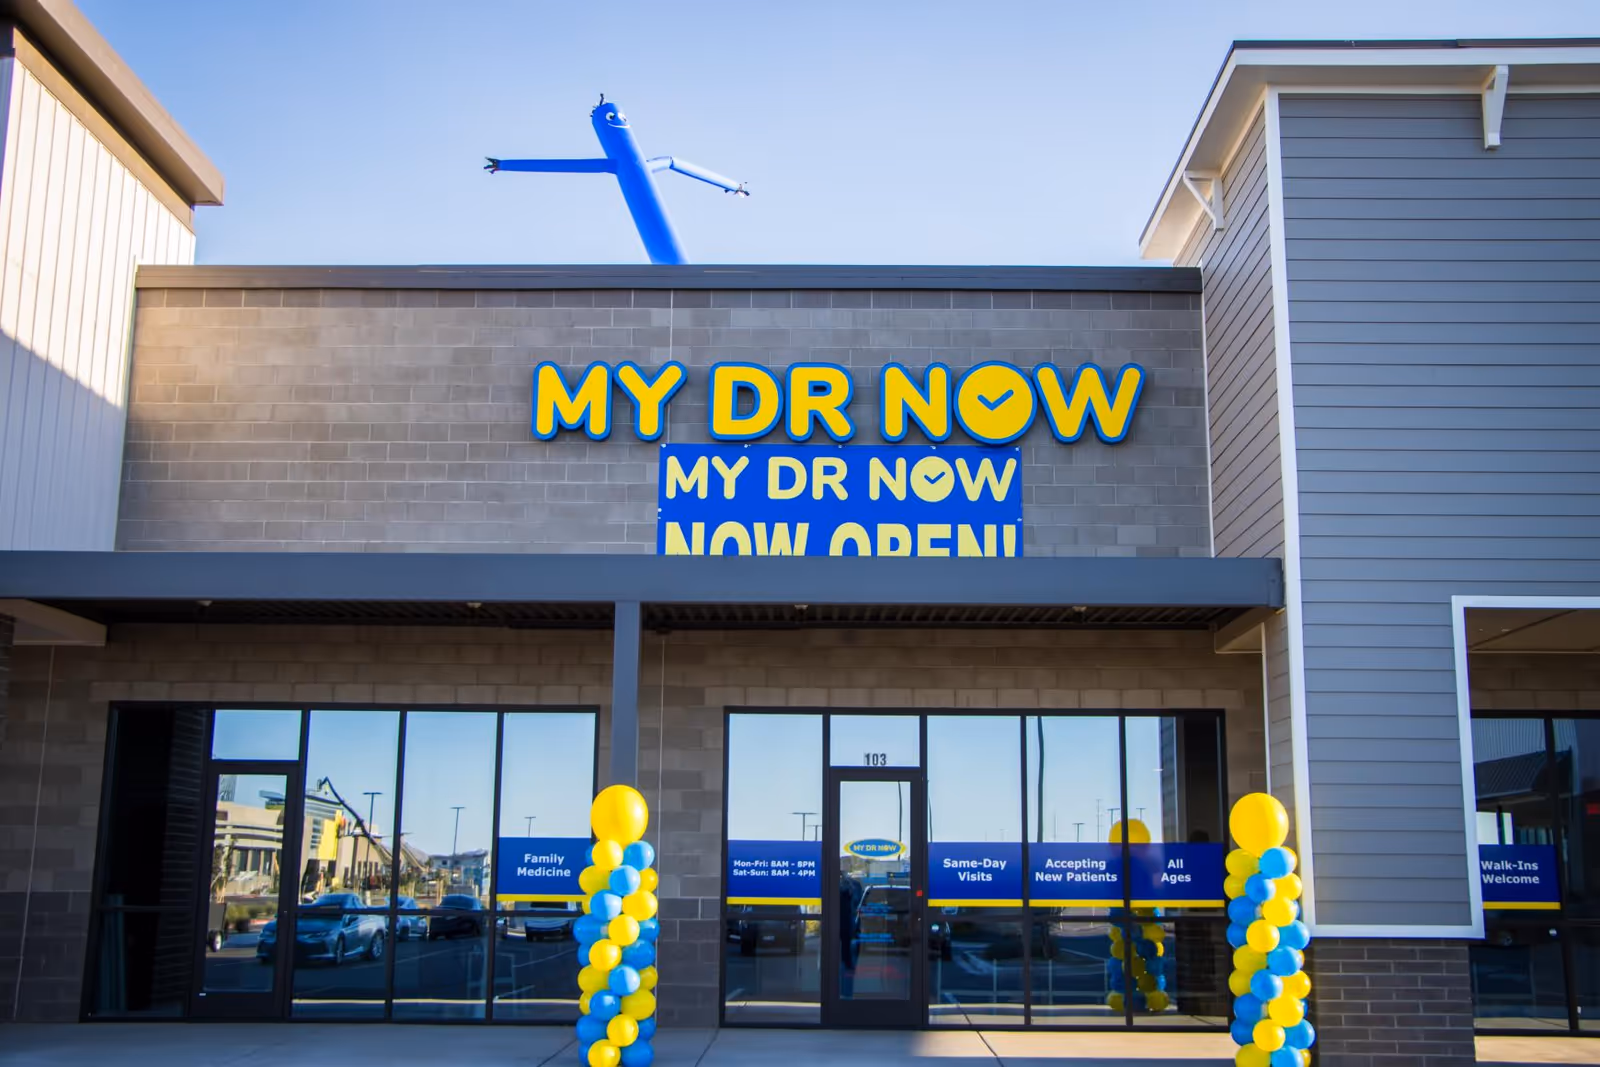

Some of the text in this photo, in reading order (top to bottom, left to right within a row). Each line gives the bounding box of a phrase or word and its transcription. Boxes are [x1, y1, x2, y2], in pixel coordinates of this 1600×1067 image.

[533, 361, 1145, 445] MY DR NOW
[666, 455, 1017, 503] MY DR NOW
[864, 753, 887, 767] 103
[524, 853, 565, 866] Family
[770, 860, 789, 868] 8AM
[943, 858, 1007, 870] Same-Day
[1045, 858, 1107, 870] Accepting
[1167, 859, 1184, 869] All
[1481, 860, 1539, 871] Walk-Ins
[517, 866, 571, 877] Medicine
[732, 868, 769, 876] Sat-Sun:
[770, 869, 789, 877] 8AM
[797, 869, 816, 877] 4PM
[958, 871, 993, 882] Visits
[1035, 871, 1118, 882] New Patients
[1160, 872, 1192, 884] Ages
[1482, 873, 1540, 884] Welcome
